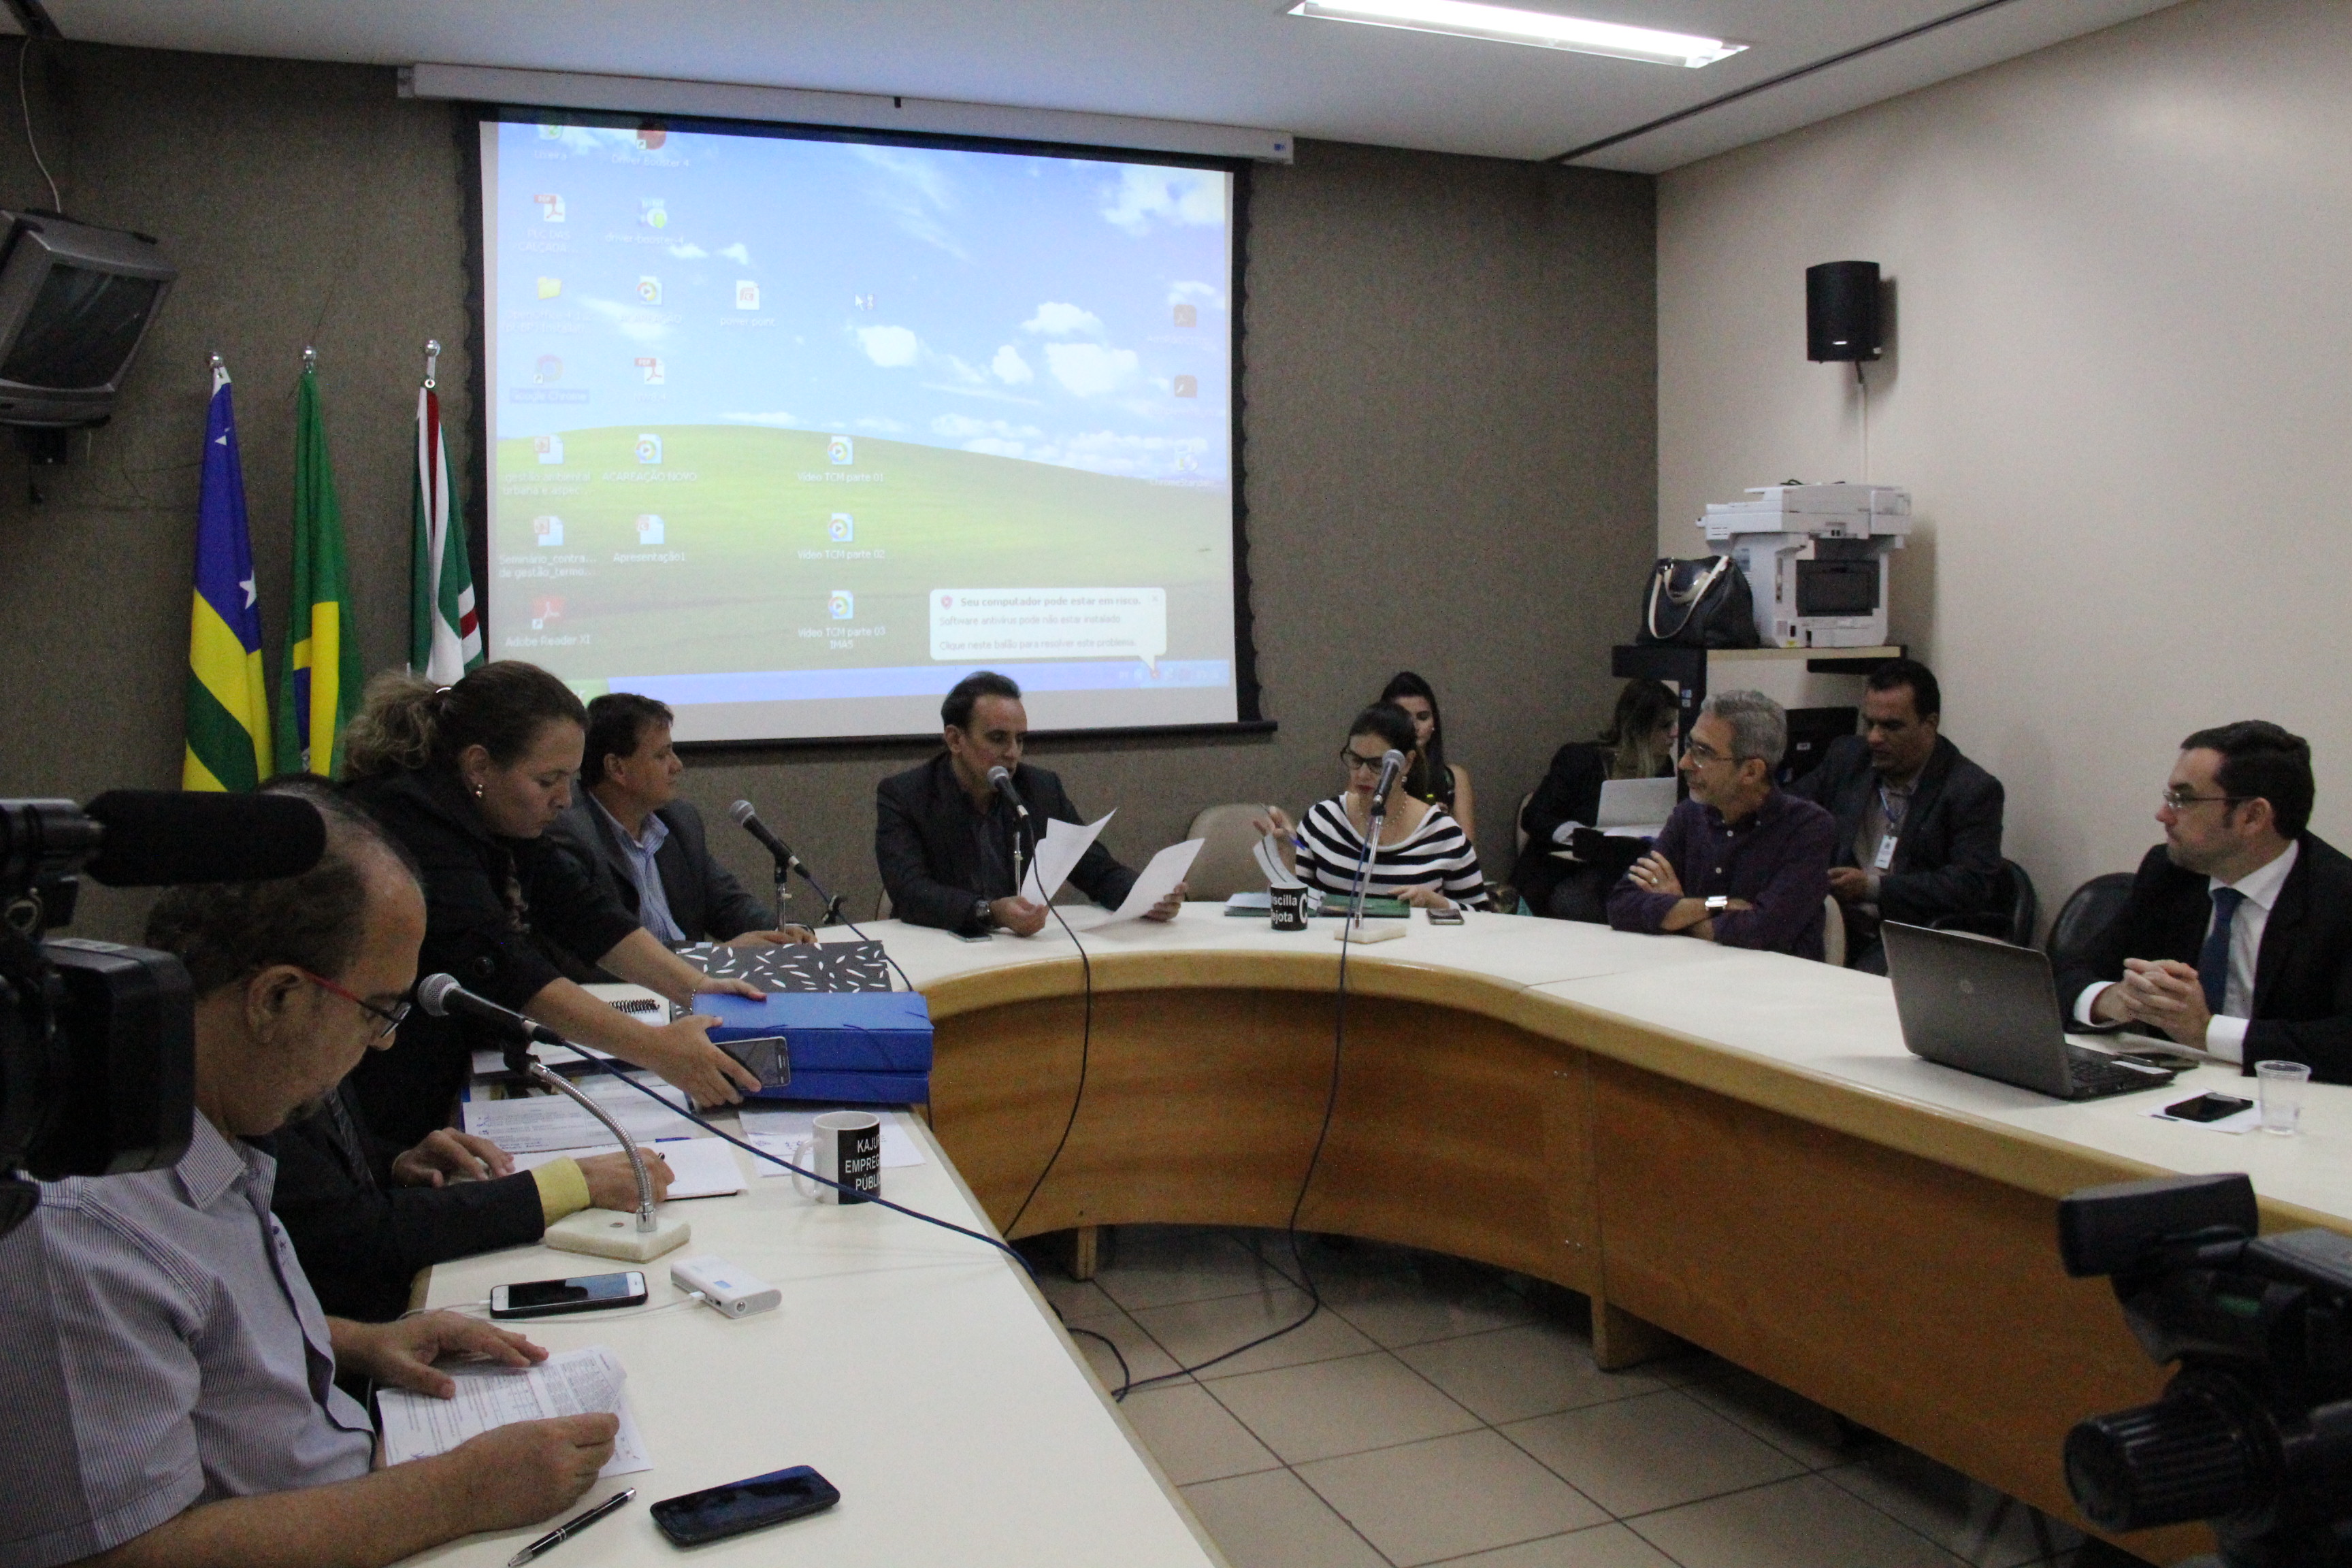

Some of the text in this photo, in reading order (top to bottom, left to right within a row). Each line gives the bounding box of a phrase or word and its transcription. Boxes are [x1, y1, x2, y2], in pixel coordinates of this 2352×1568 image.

[612, 154, 641, 165] Driver
[643, 156, 680, 167] Booster
[668, 471, 697, 481] NOVO
[824, 472, 845, 482] TCM
[846, 472, 871, 483] parte
[873, 472, 884, 482] 01
[825, 549, 845, 559] TCM
[846, 550, 872, 561] parte
[873, 549, 885, 559] 02
[499, 568, 512, 578] de
[960, 595, 1142, 608] Seu computador pode estar em risco.
[939, 615, 979, 626] Software
[1019, 615, 1041, 626] pode
[1042, 615, 1059, 624] não
[1061, 615, 1082, 625] estar
[1084, 614, 1121, 624] instalado
[825, 627, 846, 638] TCM
[847, 627, 872, 638] parte
[874, 625, 886, 636] 03
[505, 636, 538, 647] Adobe
[540, 635, 577, 646] Reader
[830, 639, 854, 650] IMAS
[939, 640, 965, 651] Clique
[968, 640, 992, 650] neste
[994, 639, 1017, 649] balão
[1019, 640, 1039, 651] para
[1041, 638, 1075, 649] resolver
[1077, 639, 1094, 647] este
[1271, 909, 1293, 924] ejota
